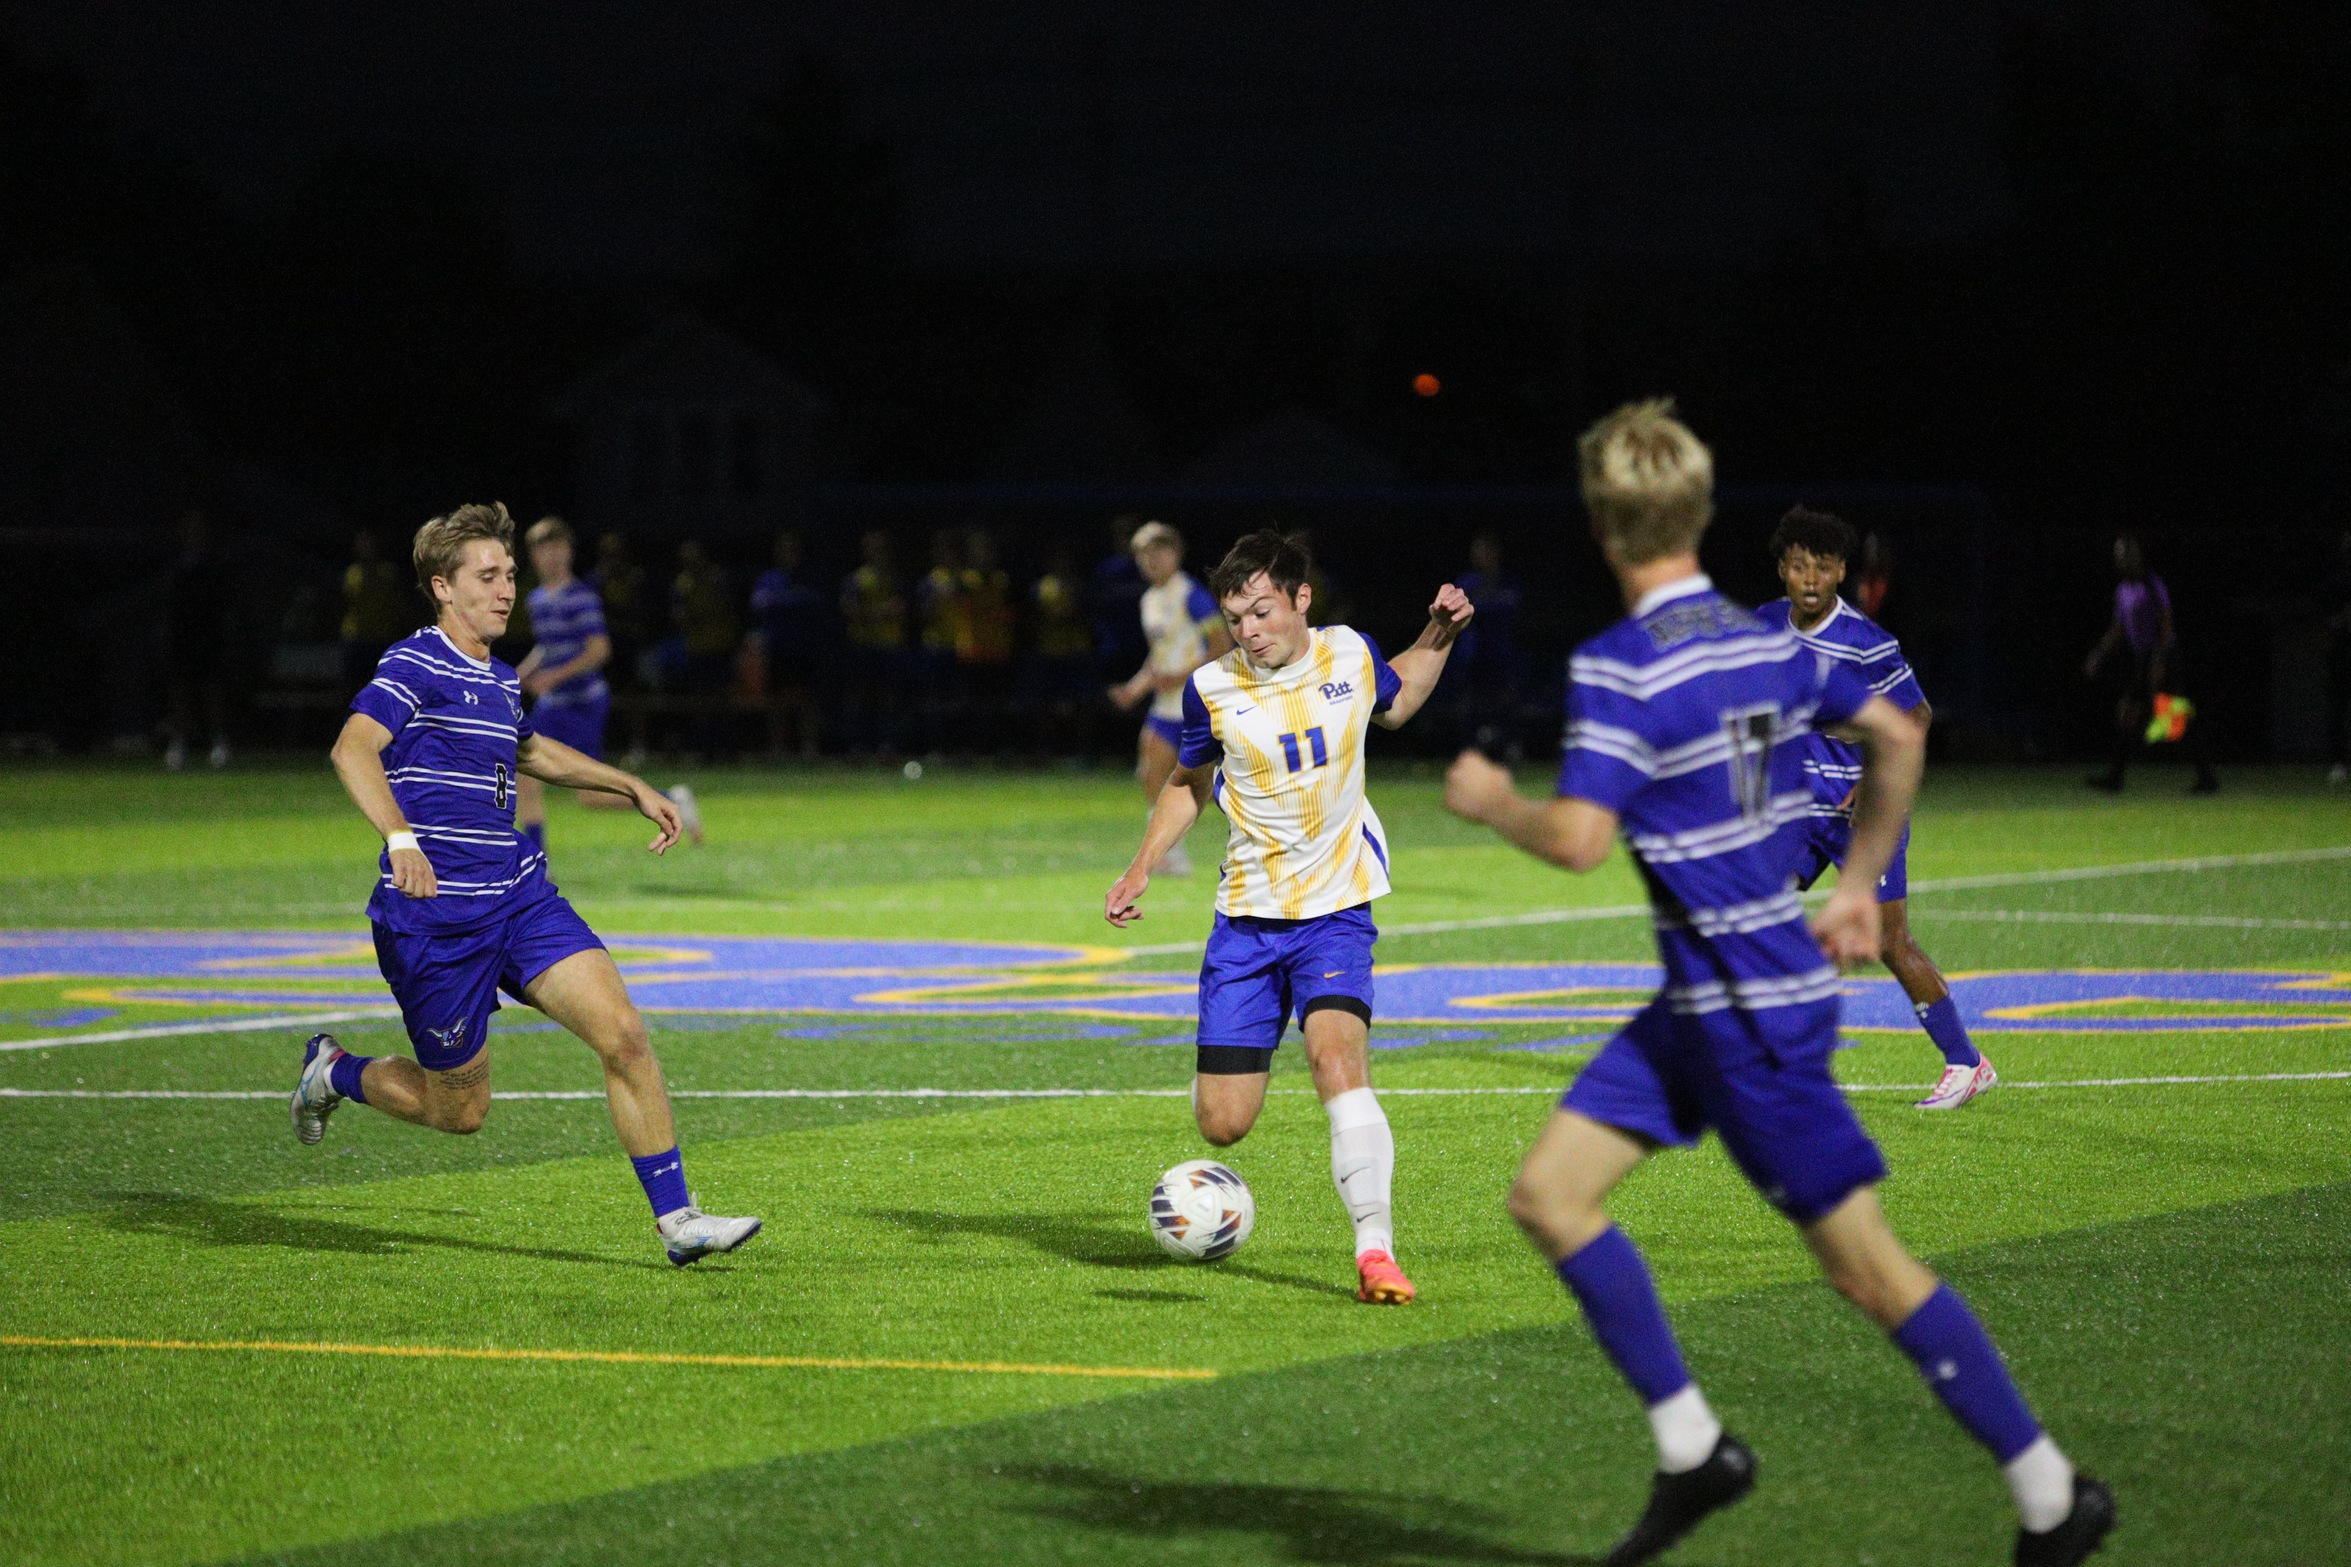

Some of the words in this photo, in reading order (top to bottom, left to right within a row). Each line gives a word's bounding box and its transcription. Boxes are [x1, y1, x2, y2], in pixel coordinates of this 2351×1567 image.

[1318, 681, 1353, 700] Pitt
[1276, 725, 1329, 775] 11
[494, 763, 508, 809] 8
